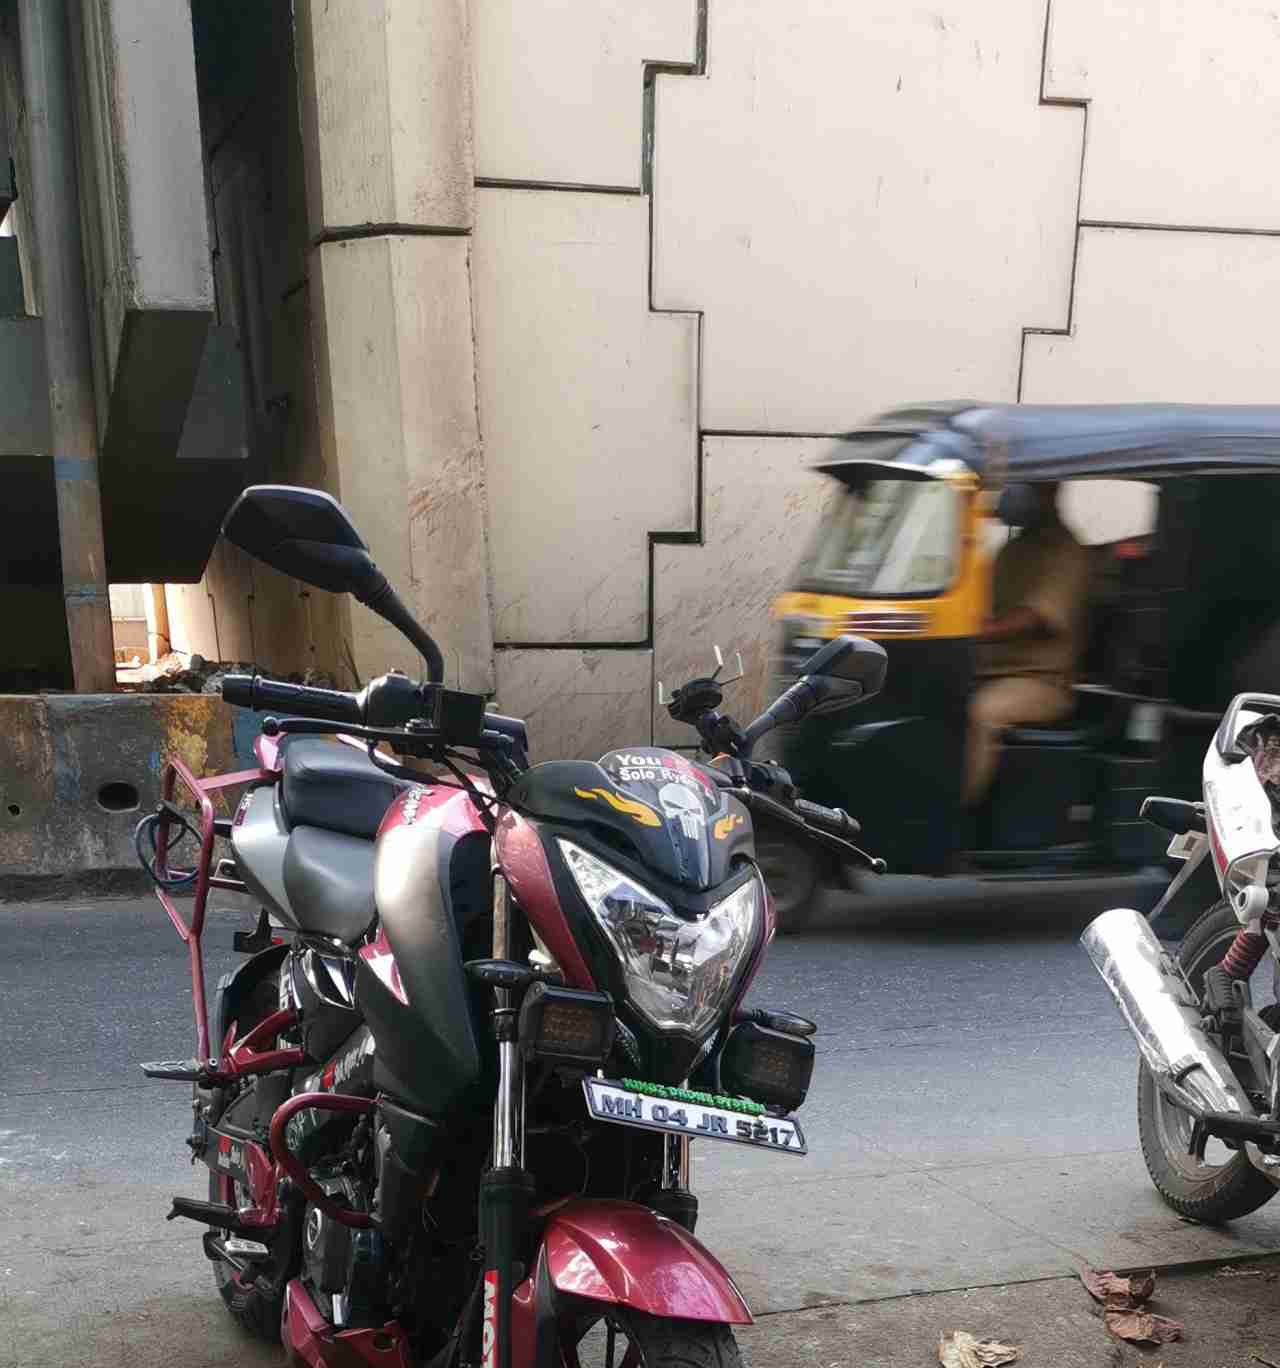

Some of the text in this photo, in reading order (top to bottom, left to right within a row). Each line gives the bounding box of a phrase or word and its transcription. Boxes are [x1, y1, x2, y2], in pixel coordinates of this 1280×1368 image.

[601, 1094, 642, 1119] MH
[652, 1104, 688, 1127] 04
[696, 1113, 728, 1134] JR
